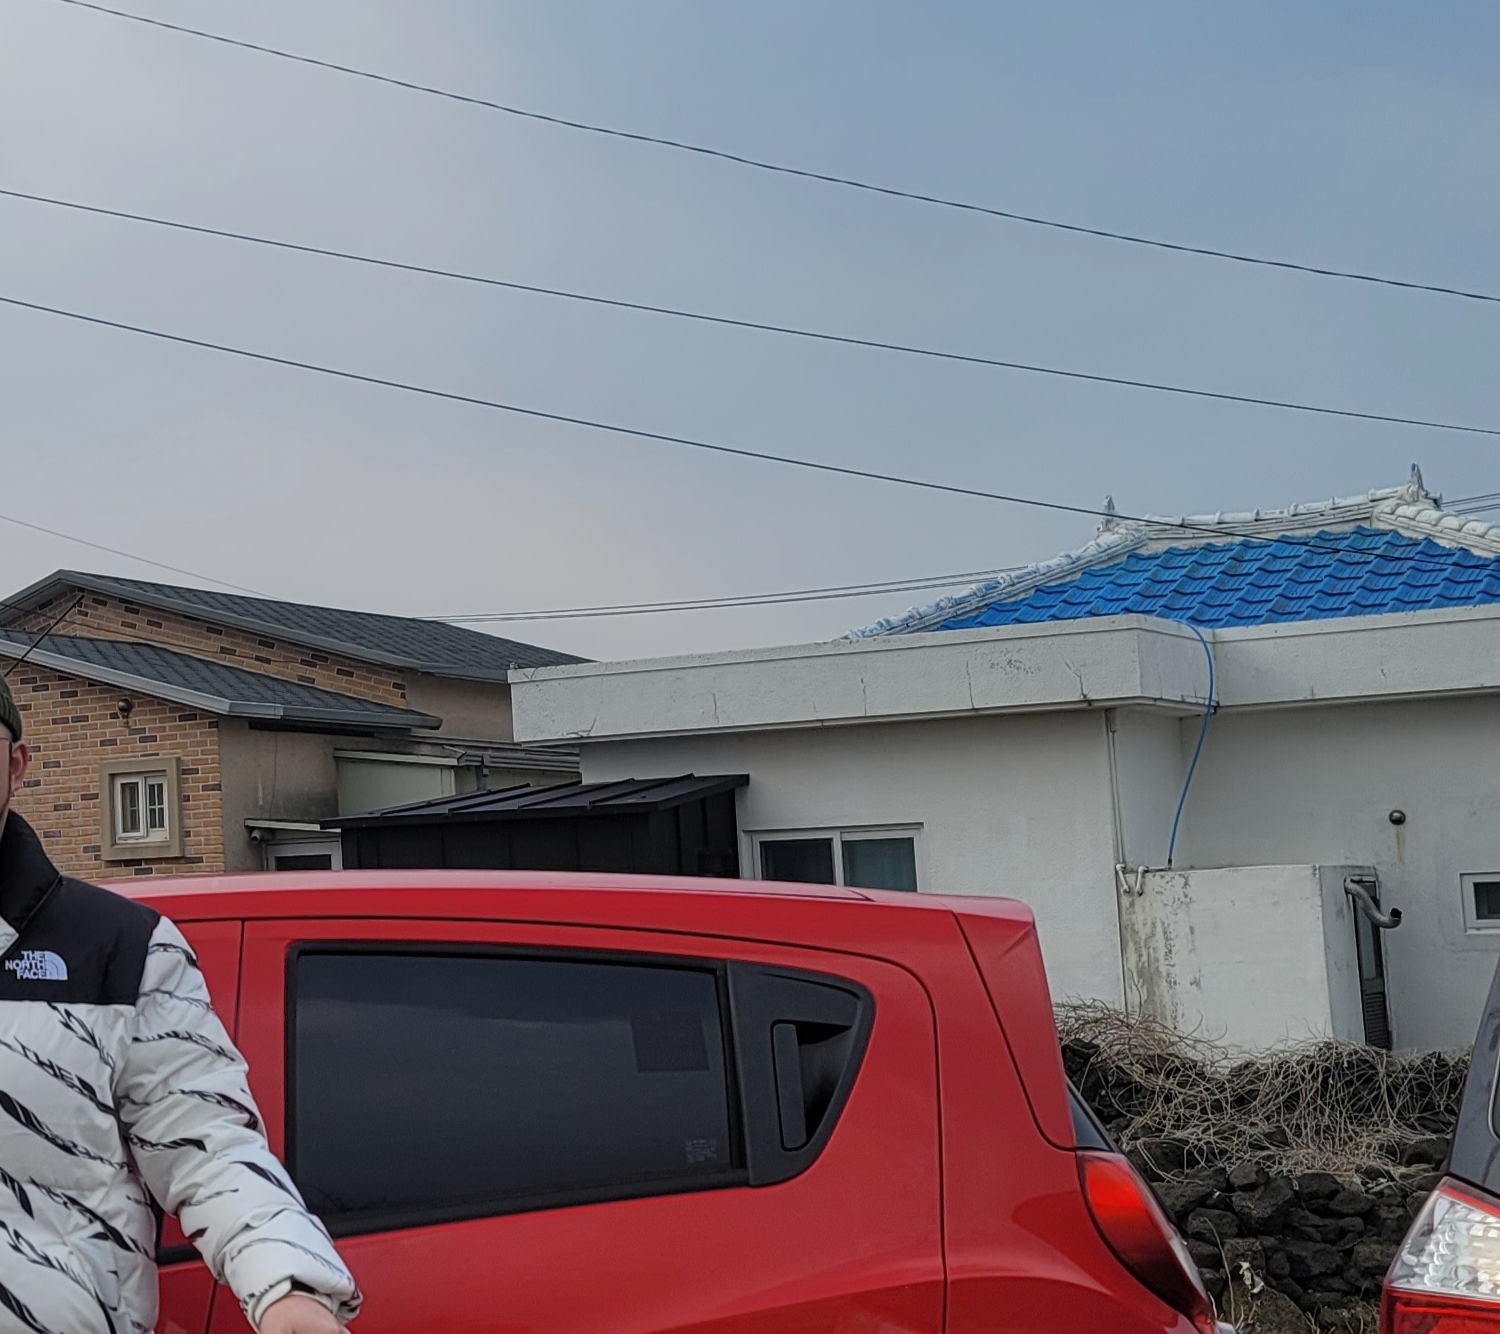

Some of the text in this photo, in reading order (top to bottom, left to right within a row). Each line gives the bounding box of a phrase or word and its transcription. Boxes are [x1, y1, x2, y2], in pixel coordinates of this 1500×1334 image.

[20, 950, 46, 961] THE
[4, 959, 46, 971] NORTH
[16, 969, 46, 980] FACE
